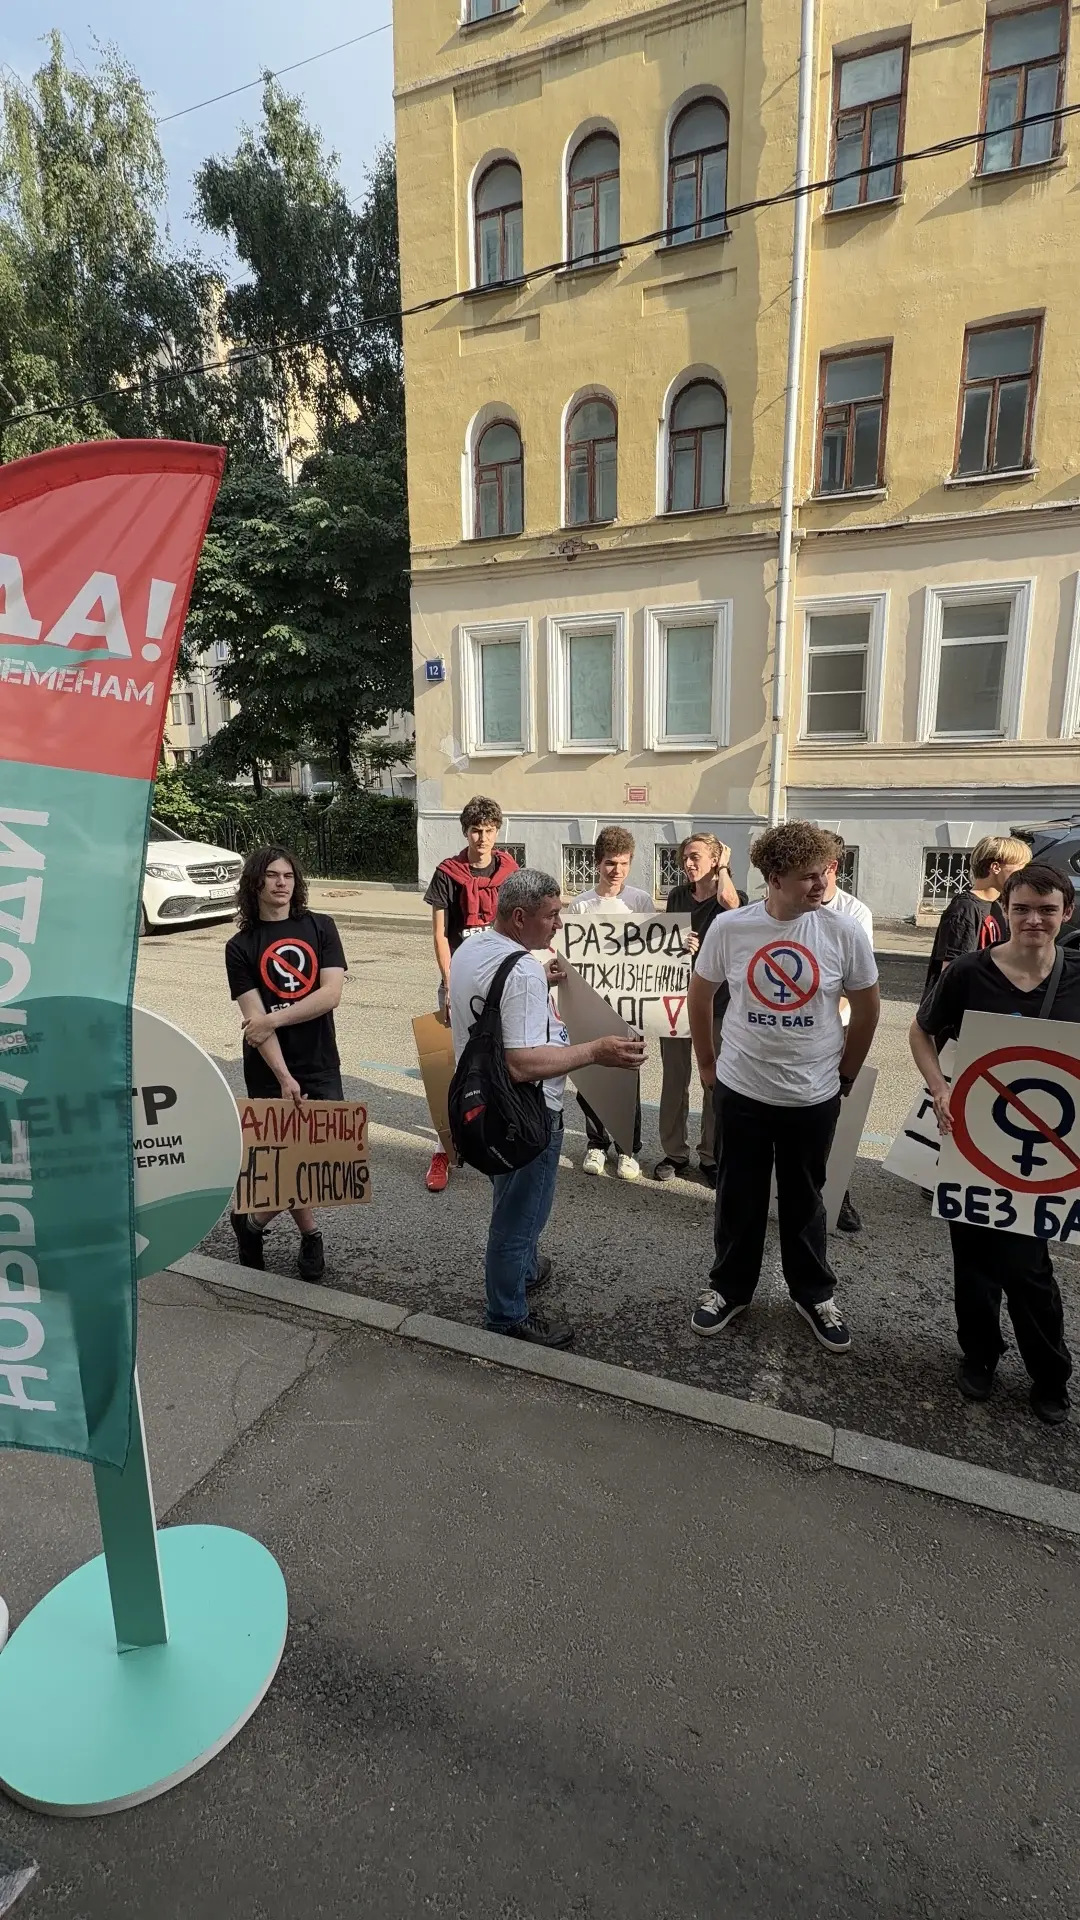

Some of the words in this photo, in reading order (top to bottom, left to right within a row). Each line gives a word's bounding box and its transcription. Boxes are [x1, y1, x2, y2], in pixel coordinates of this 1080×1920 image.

[0, 657, 154, 706] ЕМЕНАМ
[429, 665, 439, 676] 12
[564, 921, 691, 959] РАЗВОД
[748, 1011, 777, 1027] БЕЗ
[782, 1015, 814, 1027] БАБ
[241, 1106, 367, 1151] АЛИМЕНТЫ?
[133, 1151, 186, 1169] ЕРЯМ
[296, 1159, 370, 1205] СПАСИБО
[937, 1182, 1017, 1228] БЕЗ
